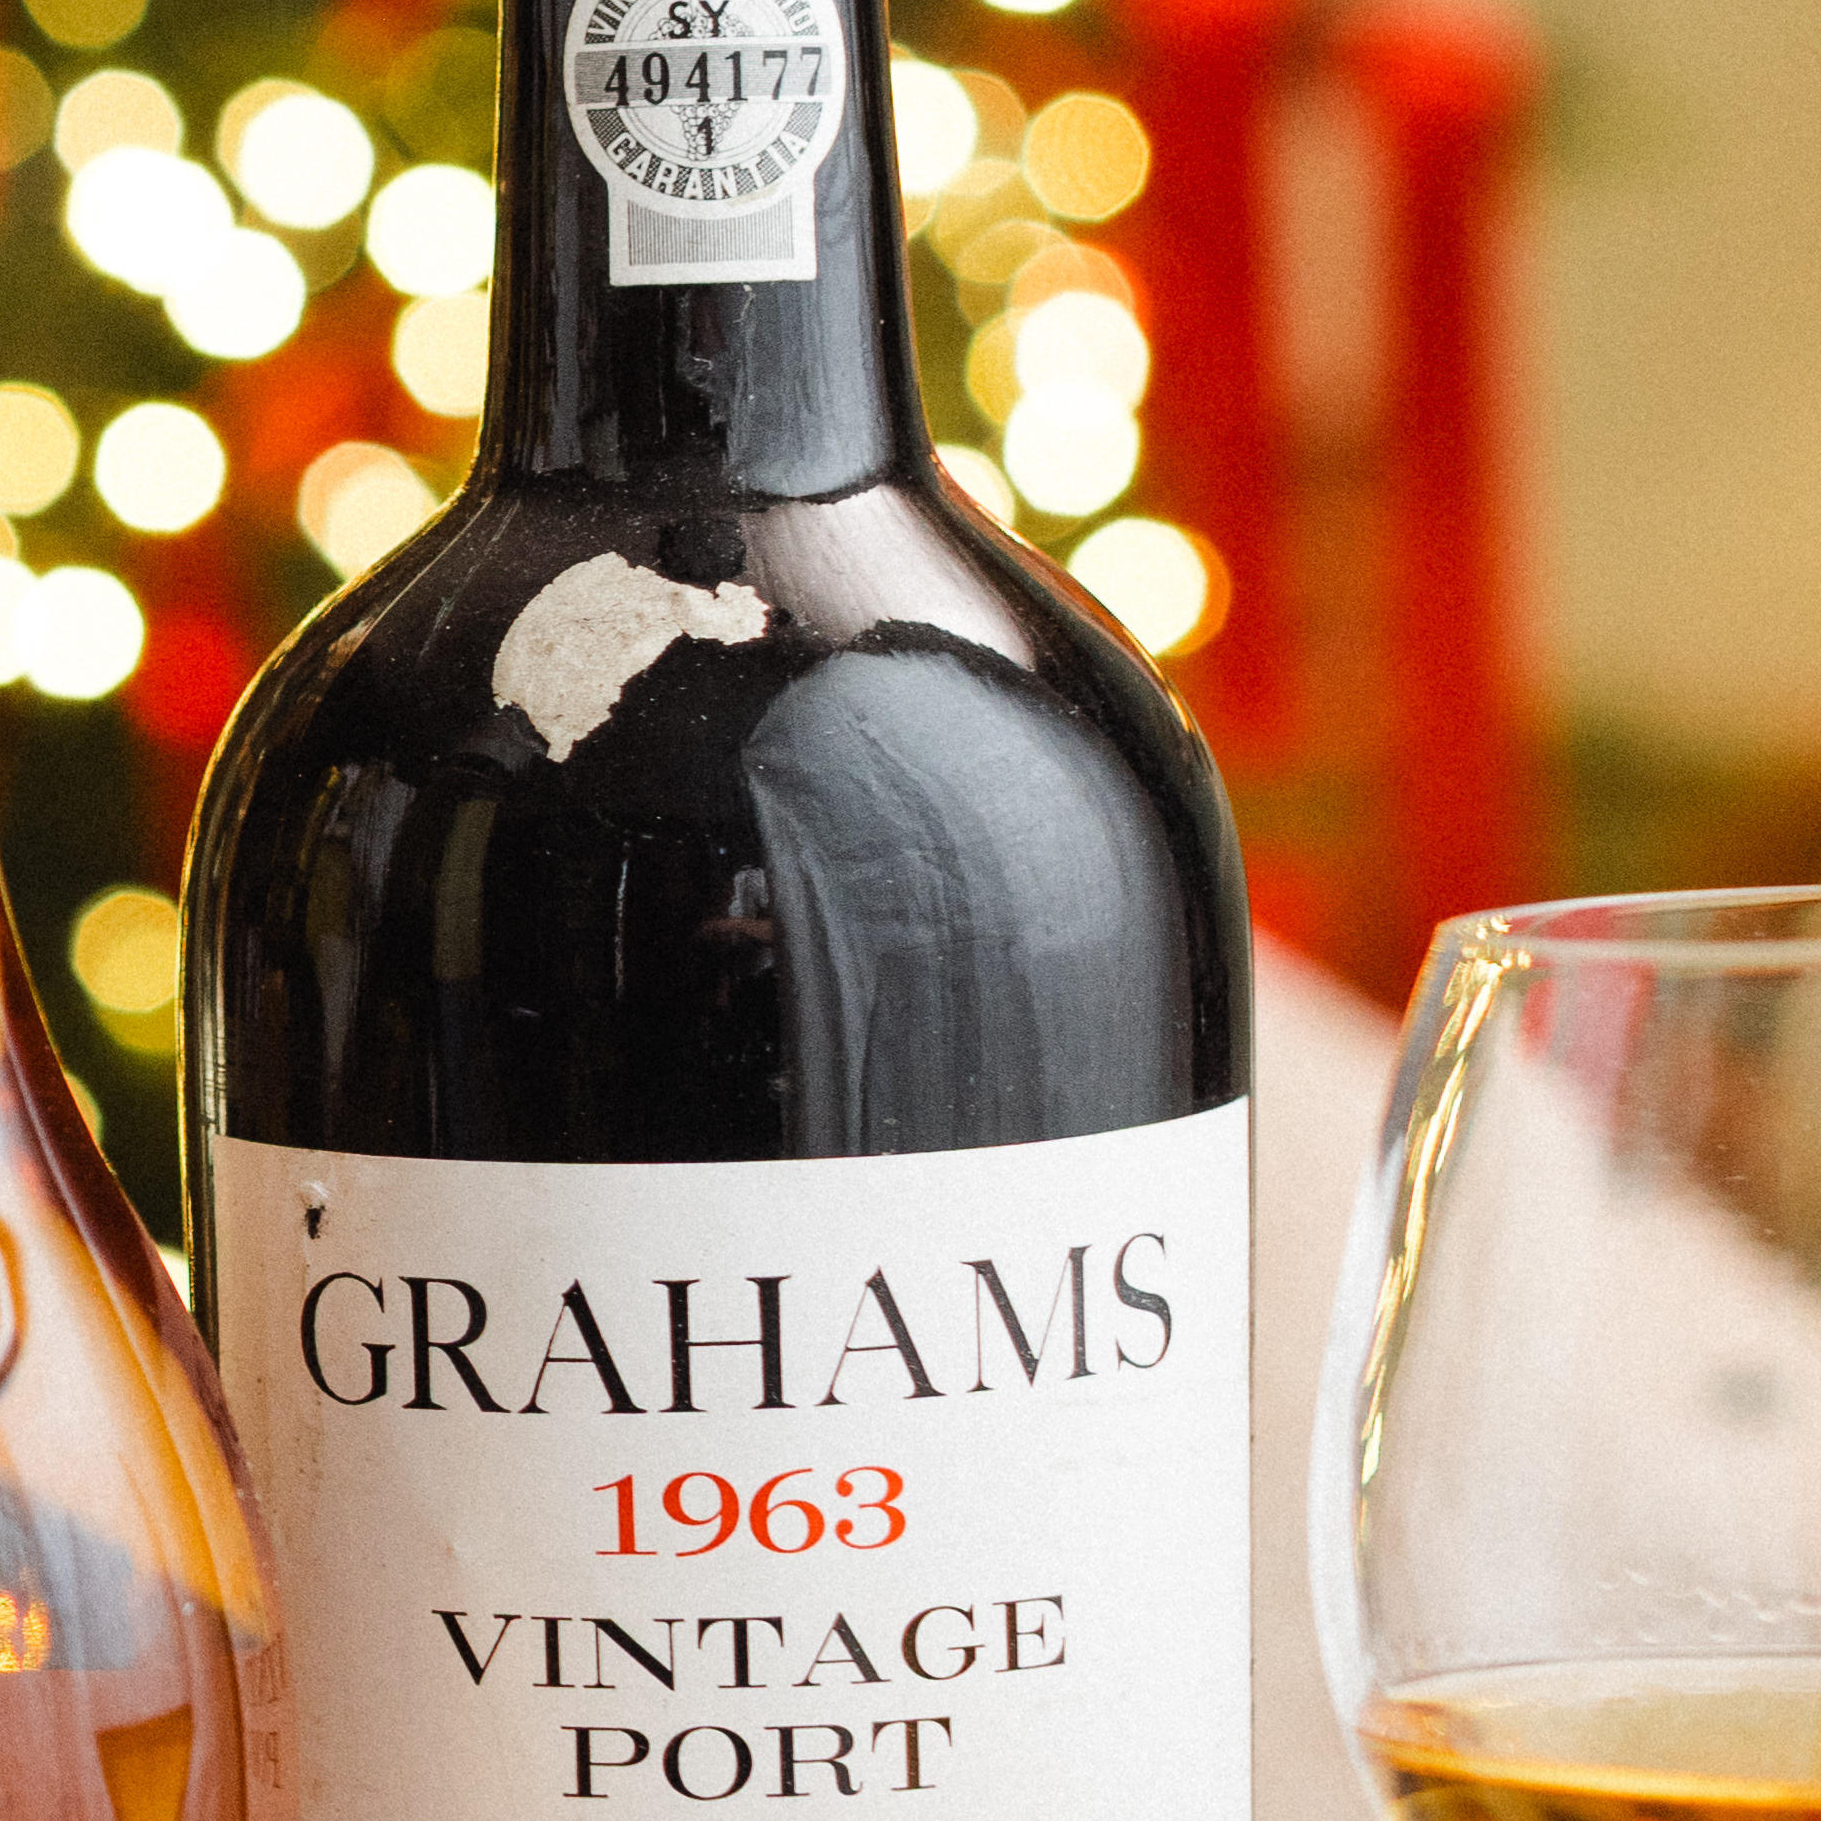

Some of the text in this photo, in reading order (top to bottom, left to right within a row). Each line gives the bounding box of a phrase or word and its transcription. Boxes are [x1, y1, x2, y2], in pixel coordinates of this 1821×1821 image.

[668, 0, 730, 39] SY
[604, 46, 823, 107] 494177
[607, 130, 807, 201] GARANTIA
[299, 1232, 1174, 1415] GRAHAMS
[591, 1464, 908, 1558] 1963
[430, 1593, 1068, 1693] VINTAGE
[559, 1715, 954, 1801] PORT
